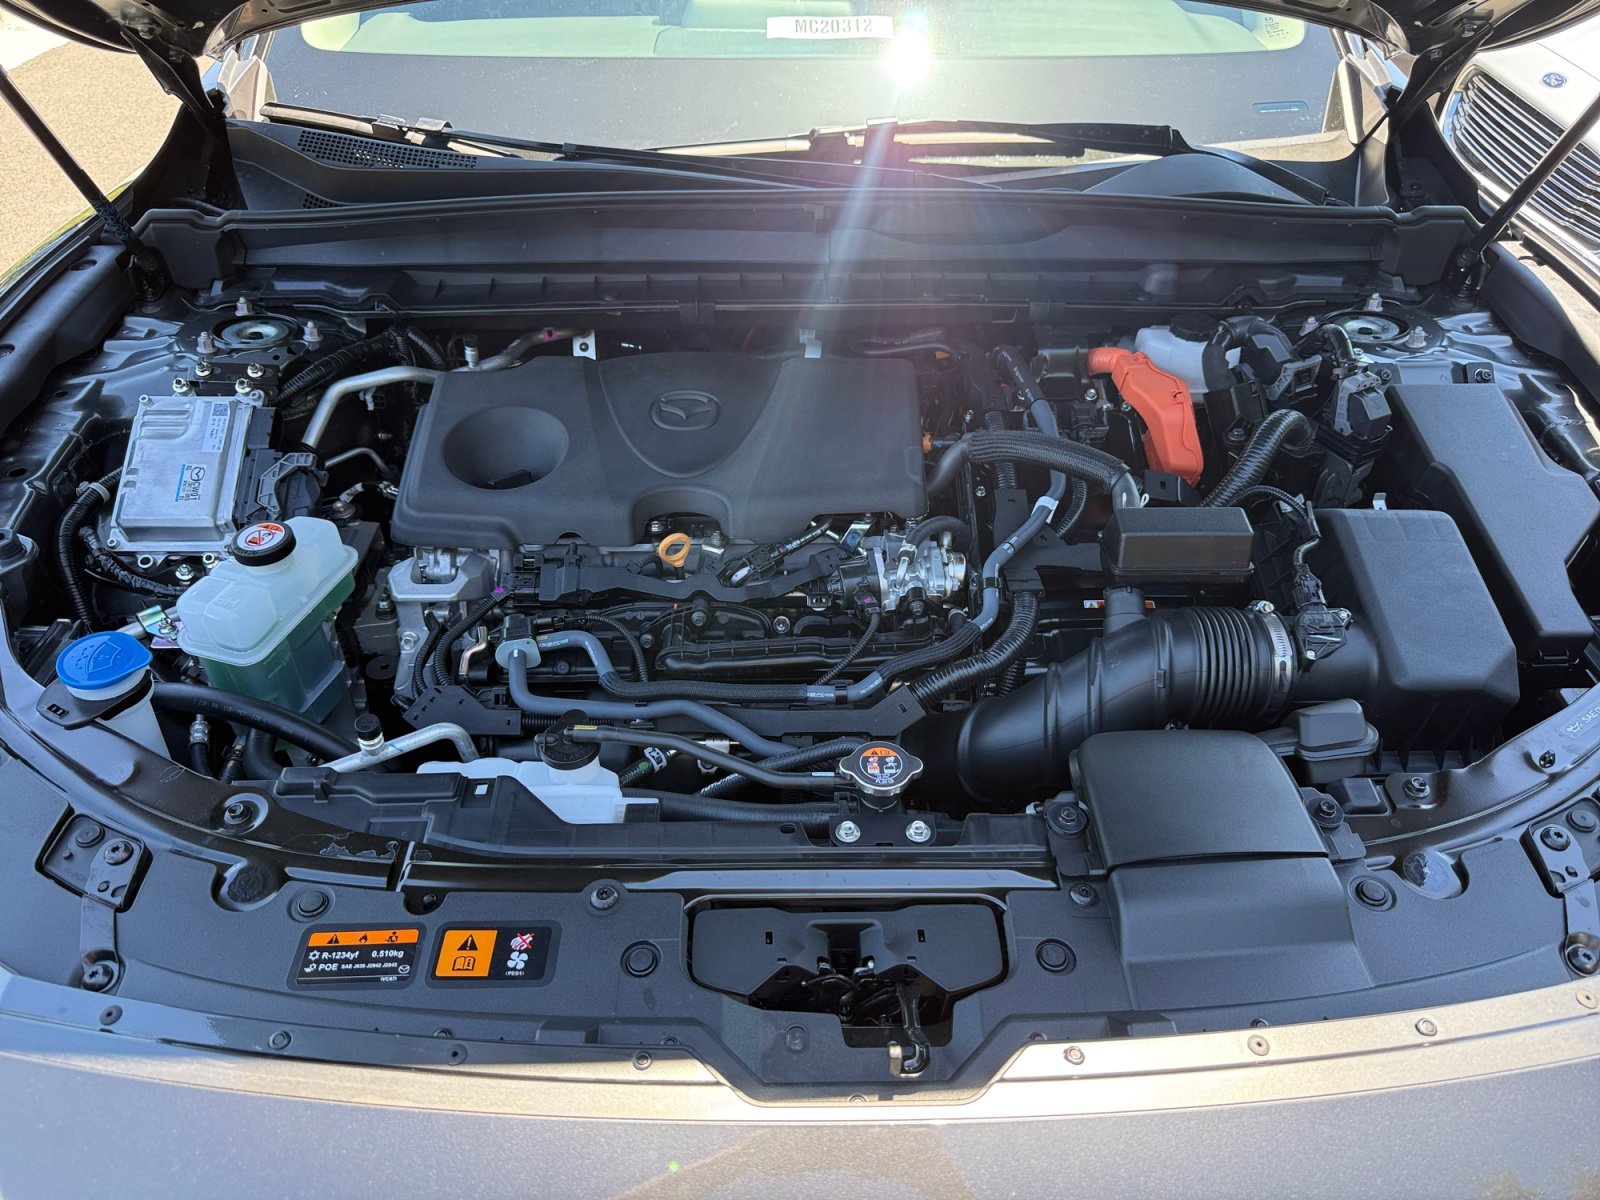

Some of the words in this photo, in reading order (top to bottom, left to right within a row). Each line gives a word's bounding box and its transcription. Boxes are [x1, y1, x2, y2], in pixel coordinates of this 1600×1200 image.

[795, 18, 873, 33] MC20312
[1581, 710, 1598, 723] SAE
[321, 951, 360, 960] R-1234yf
[371, 949, 404, 958] 0.510kg
[318, 963, 339, 971] POE
